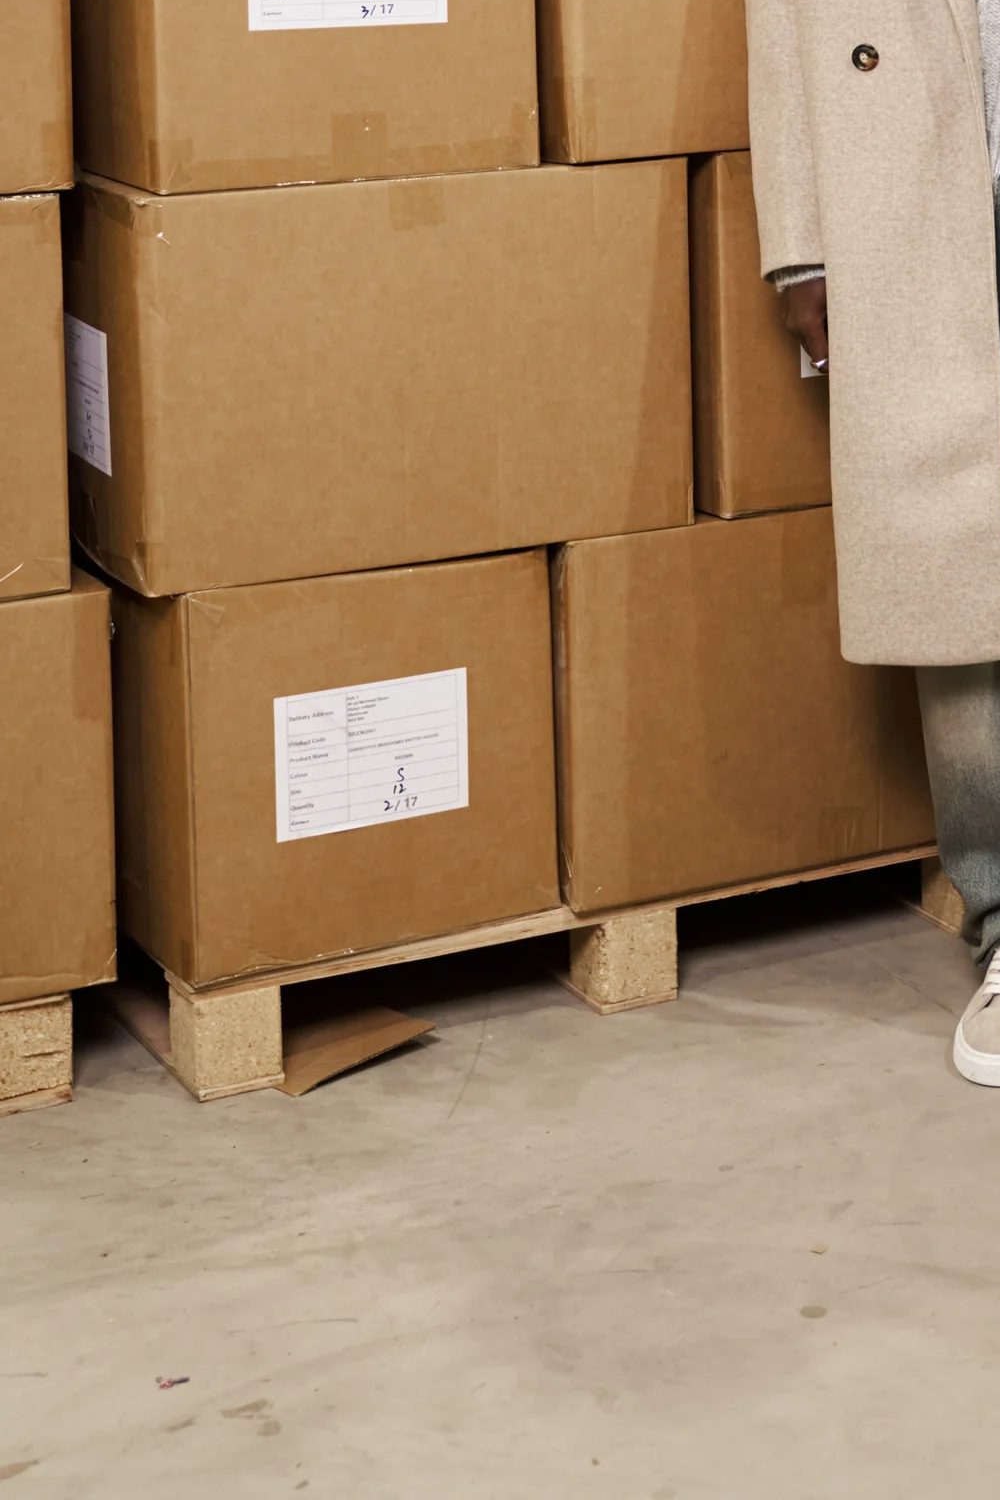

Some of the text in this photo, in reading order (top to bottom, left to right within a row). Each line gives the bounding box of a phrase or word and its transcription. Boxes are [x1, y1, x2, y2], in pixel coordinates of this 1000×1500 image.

[289, 714, 310, 723] Delivery
[289, 739, 311, 747] Product
[290, 755, 311, 763] Product
[396, 767, 405, 782] S
[393, 784, 406, 794] 12
[291, 802, 314, 811] Quantity
